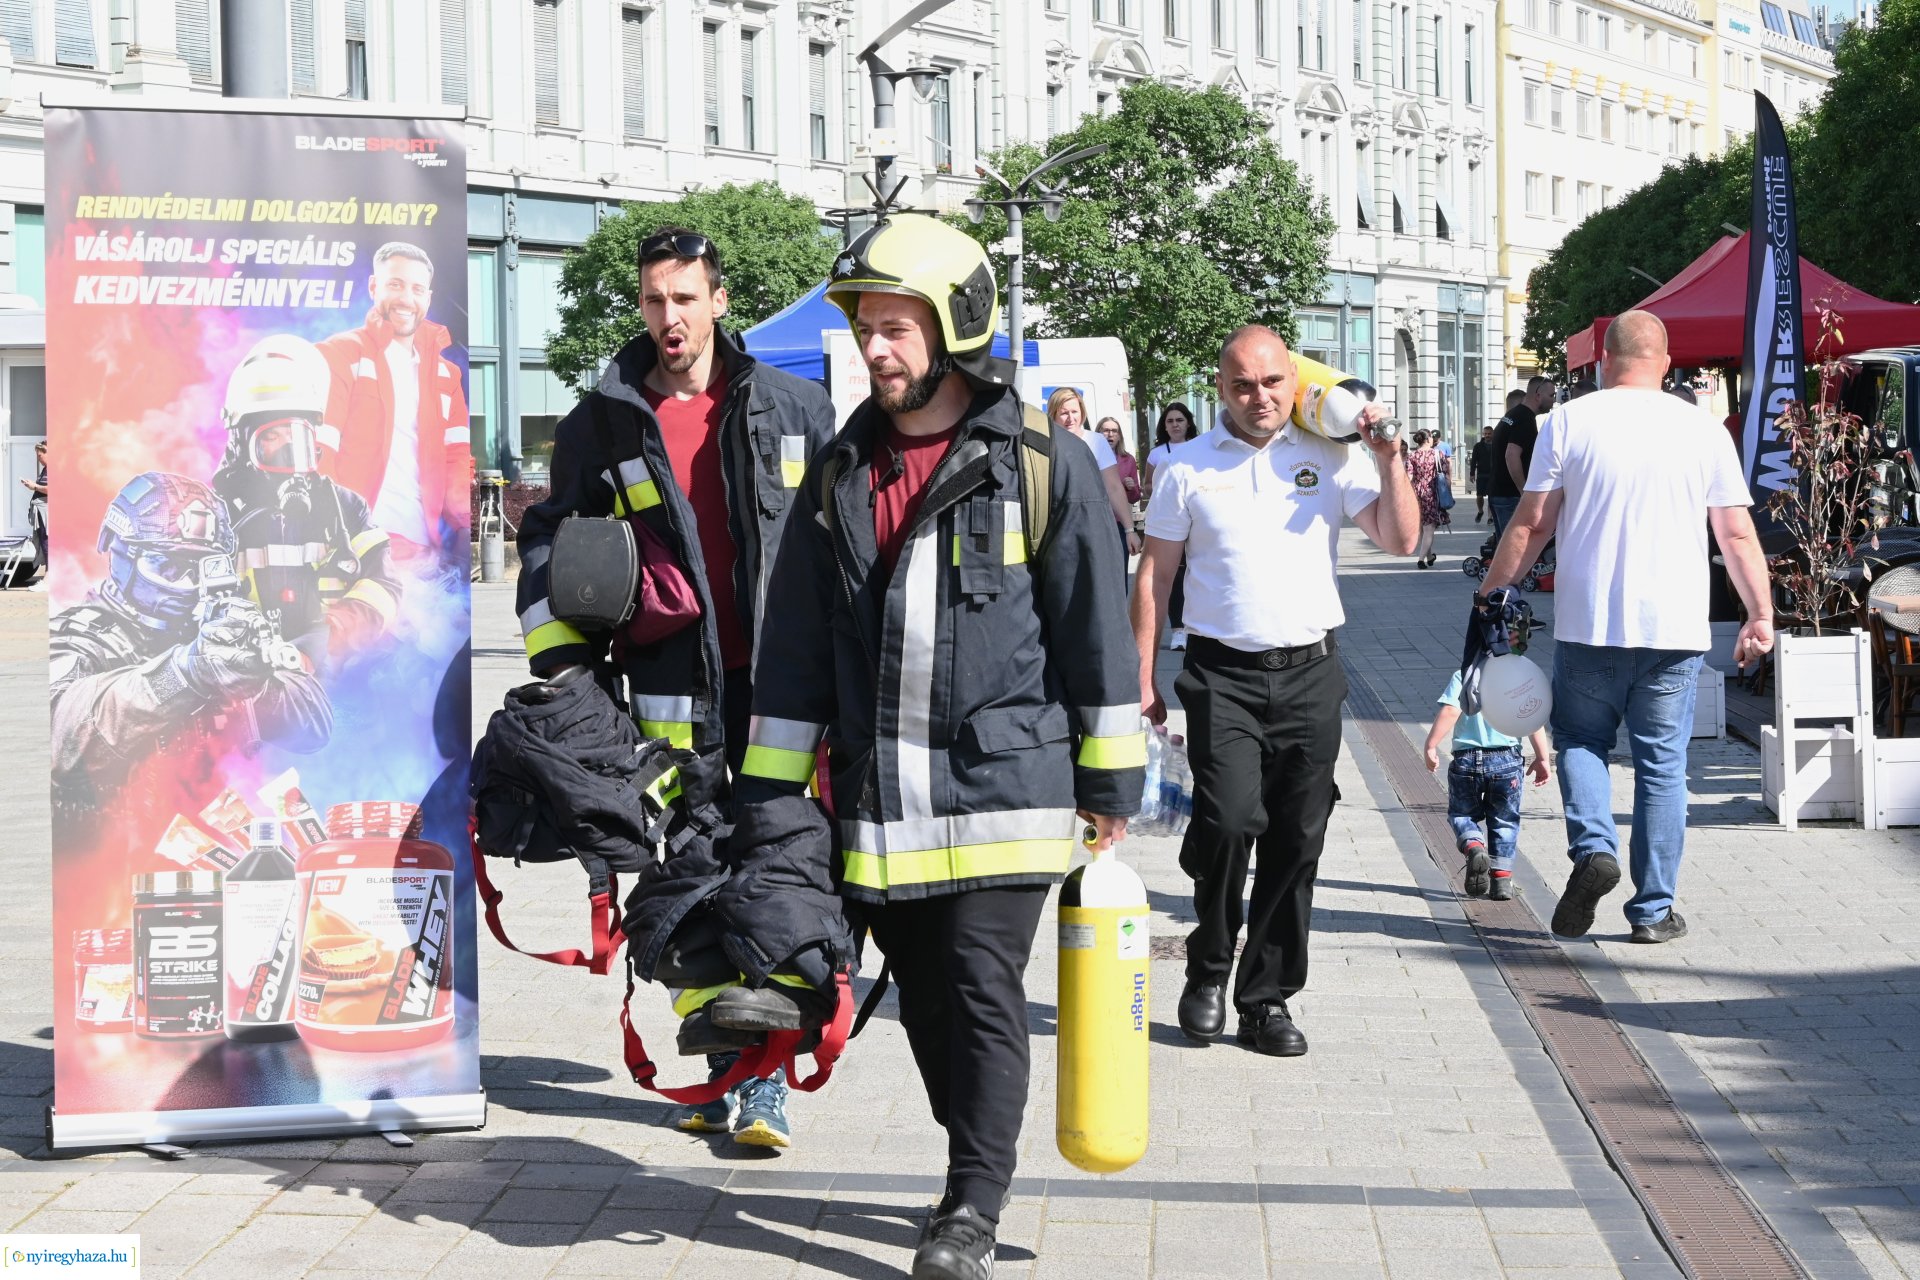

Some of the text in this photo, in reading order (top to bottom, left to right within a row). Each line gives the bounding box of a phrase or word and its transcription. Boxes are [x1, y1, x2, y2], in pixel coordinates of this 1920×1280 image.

[411, 152, 438, 161] power
[75, 192, 438, 226] RENDVÉDELMI DOLGOZÓ VAGY?
[74, 231, 355, 266] VÁSÁROLJ SPECIÁLIS
[73, 272, 354, 309] KEDVEZMÉNNYEL!
[317, 879, 340, 893] NEW
[400, 879, 449, 1016] WHEY
[150, 959, 219, 974] STRIKE
[383, 948, 415, 1021] BLADE
[245, 964, 270, 1014] BLADE
[1131, 973, 1146, 1033] Dräger
